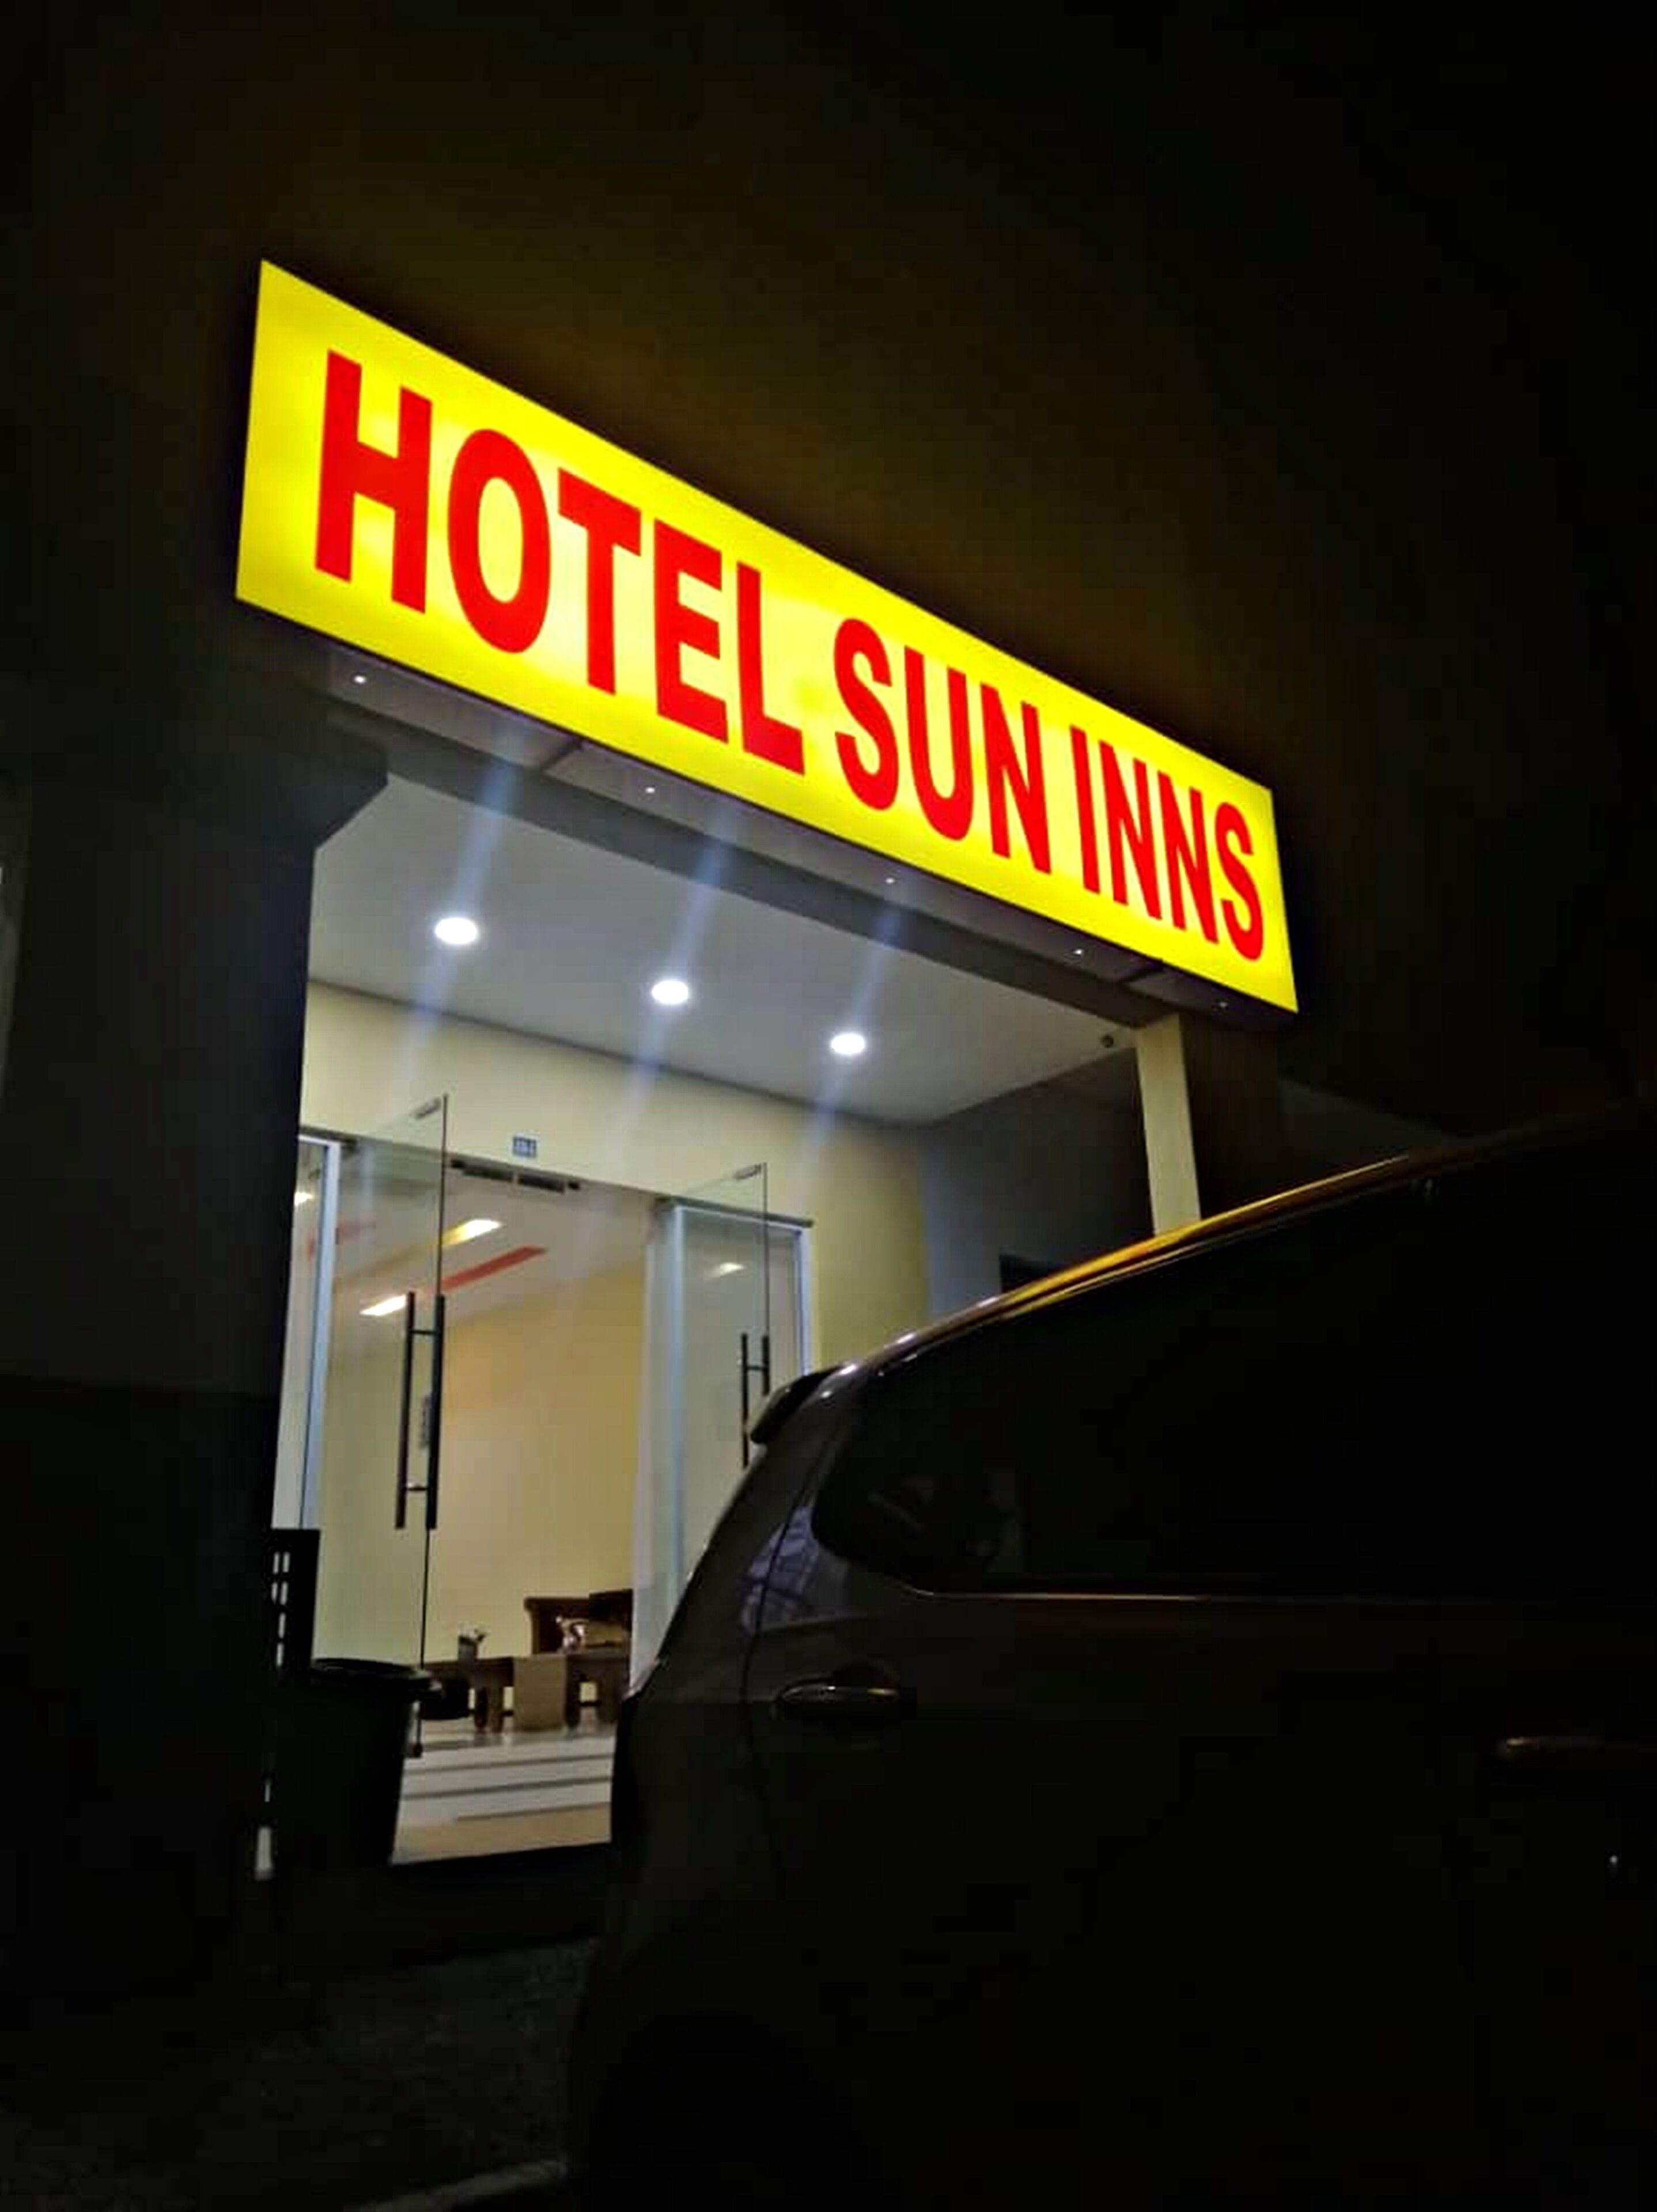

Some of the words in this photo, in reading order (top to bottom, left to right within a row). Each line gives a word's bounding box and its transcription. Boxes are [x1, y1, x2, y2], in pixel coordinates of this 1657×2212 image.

[315, 351, 804, 775] HOTEL
[834, 619, 1051, 874] SUN
[1070, 726, 1264, 961] INNS
